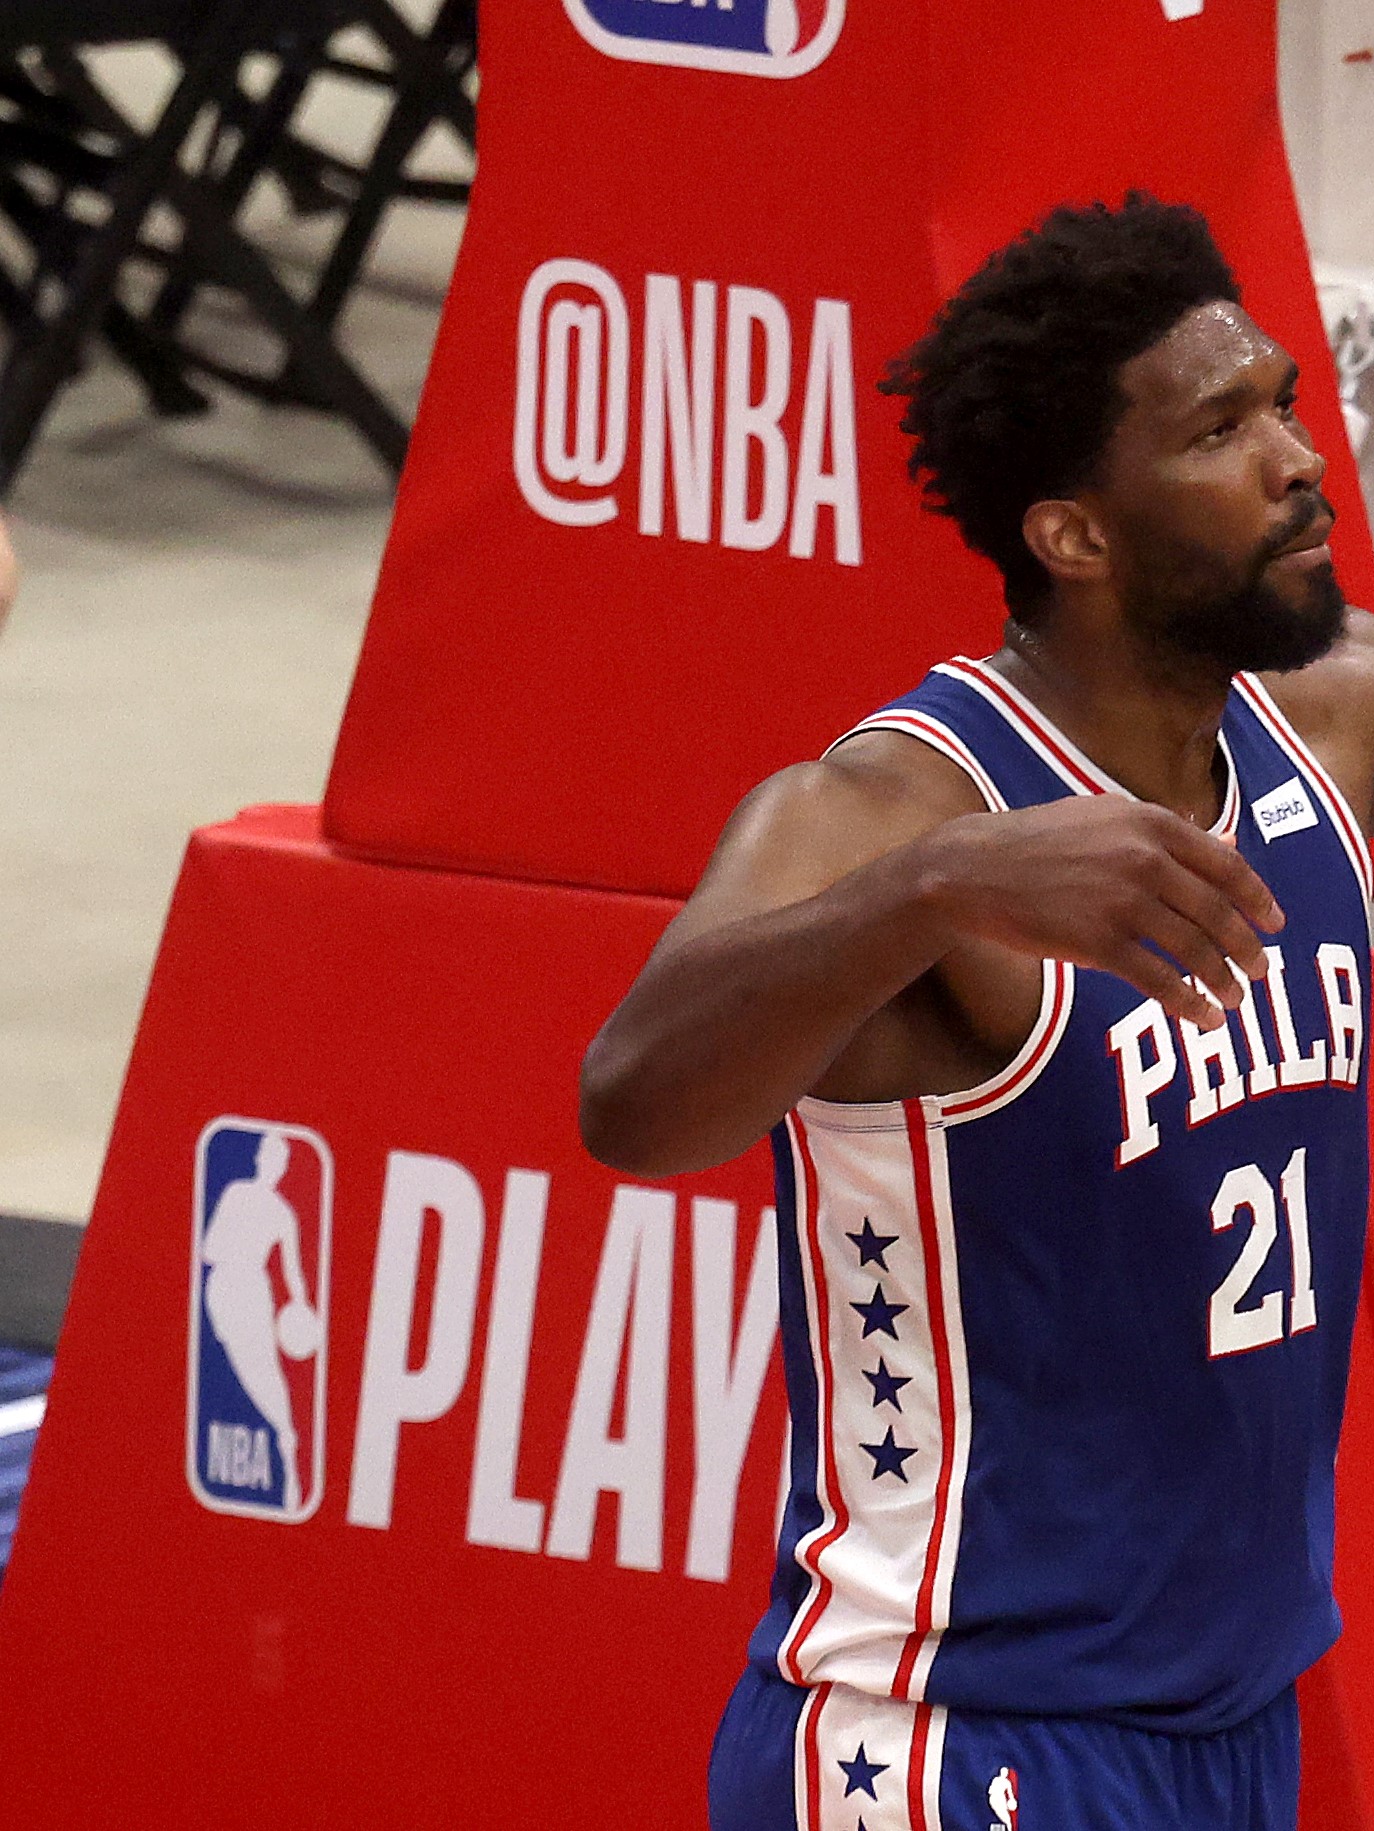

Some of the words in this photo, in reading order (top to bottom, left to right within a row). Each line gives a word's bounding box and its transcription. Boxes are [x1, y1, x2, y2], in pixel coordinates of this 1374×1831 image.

[513, 257, 863, 566] @NBA
[1106, 942, 1363, 1171] PHILA
[347, 1150, 792, 1584] PLAY
[1207, 1147, 1318, 1361] 21
[207, 1420, 272, 1491] NBA
